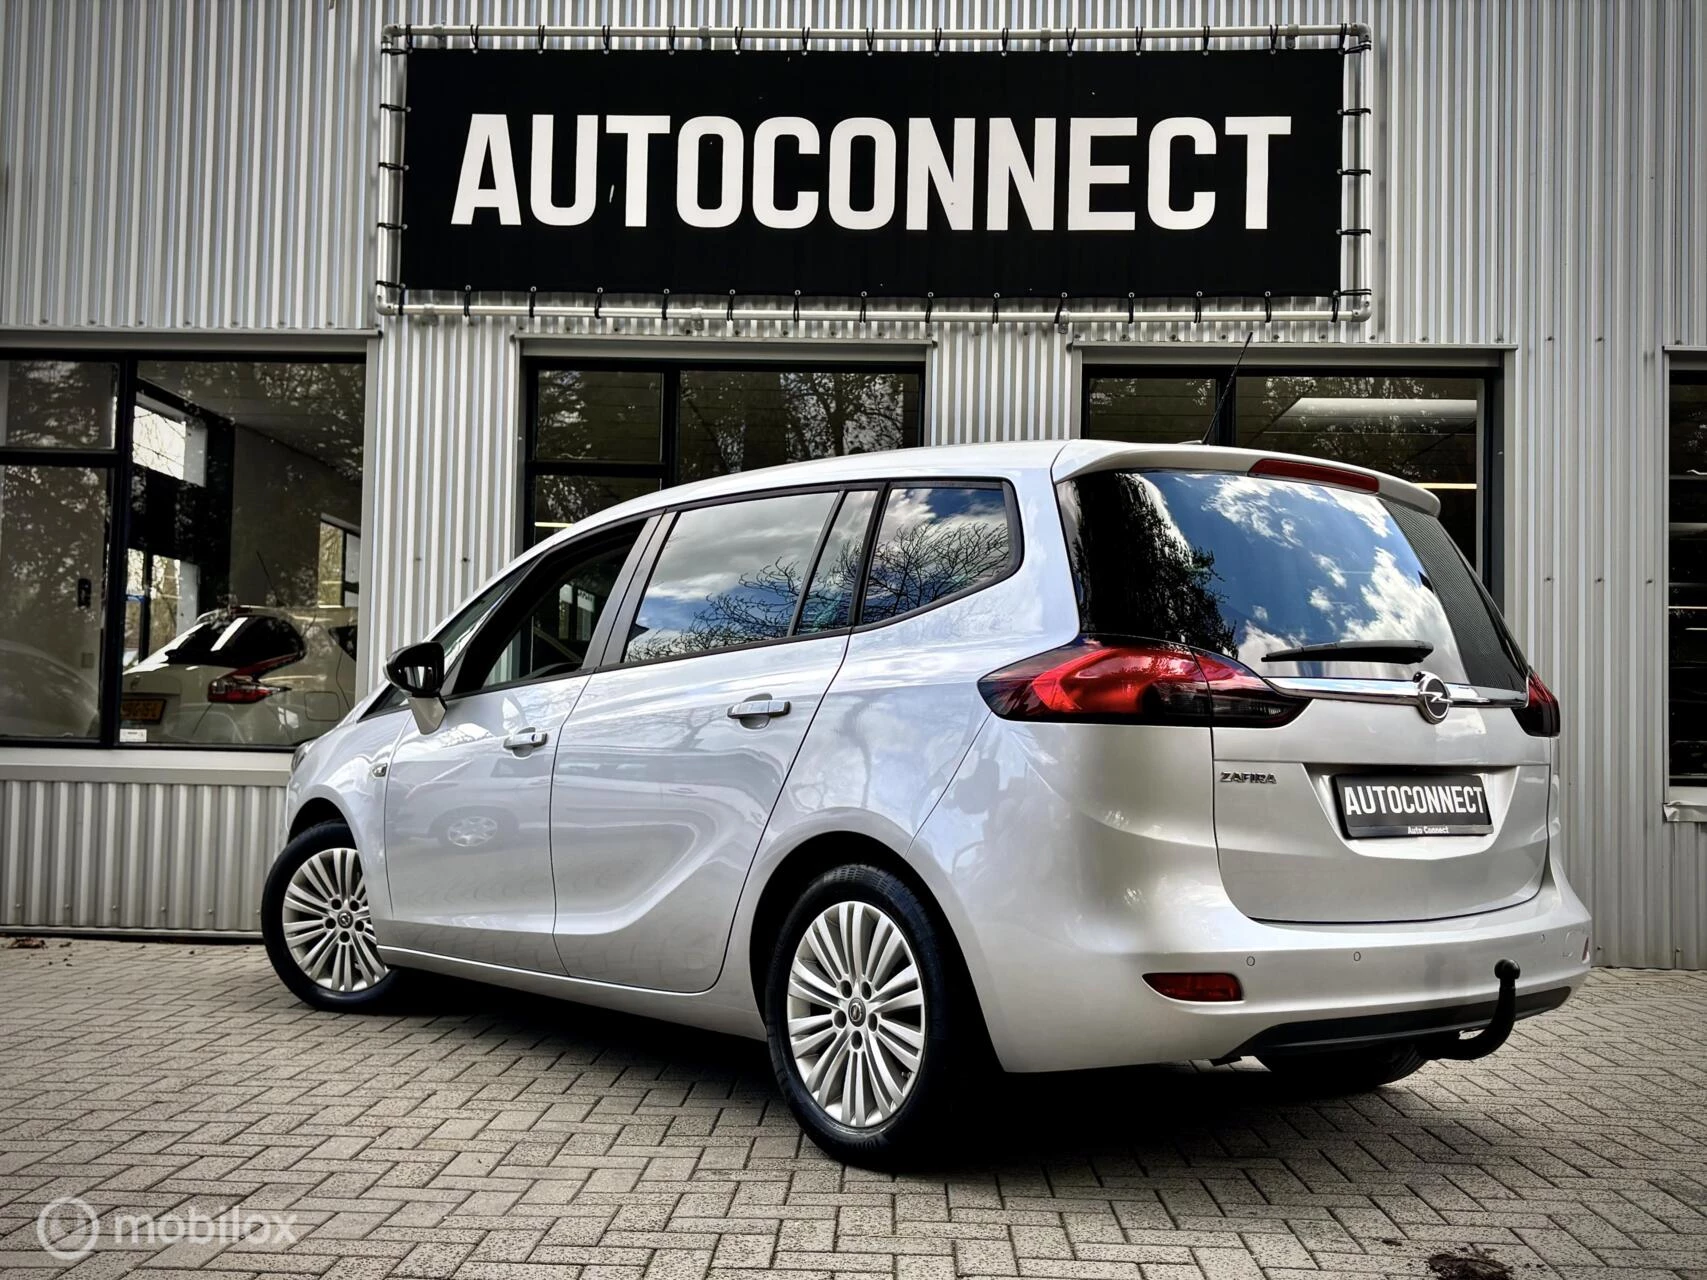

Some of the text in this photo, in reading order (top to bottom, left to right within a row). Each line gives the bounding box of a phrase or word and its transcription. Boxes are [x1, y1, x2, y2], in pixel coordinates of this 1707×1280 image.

[450, 113, 1292, 231] AUTOCONNECT
[1220, 771, 1278, 784] ZAFIRA
[1344, 785, 1484, 815] AUTOCONNECT
[1407, 825, 1449, 835] Auto Connect
